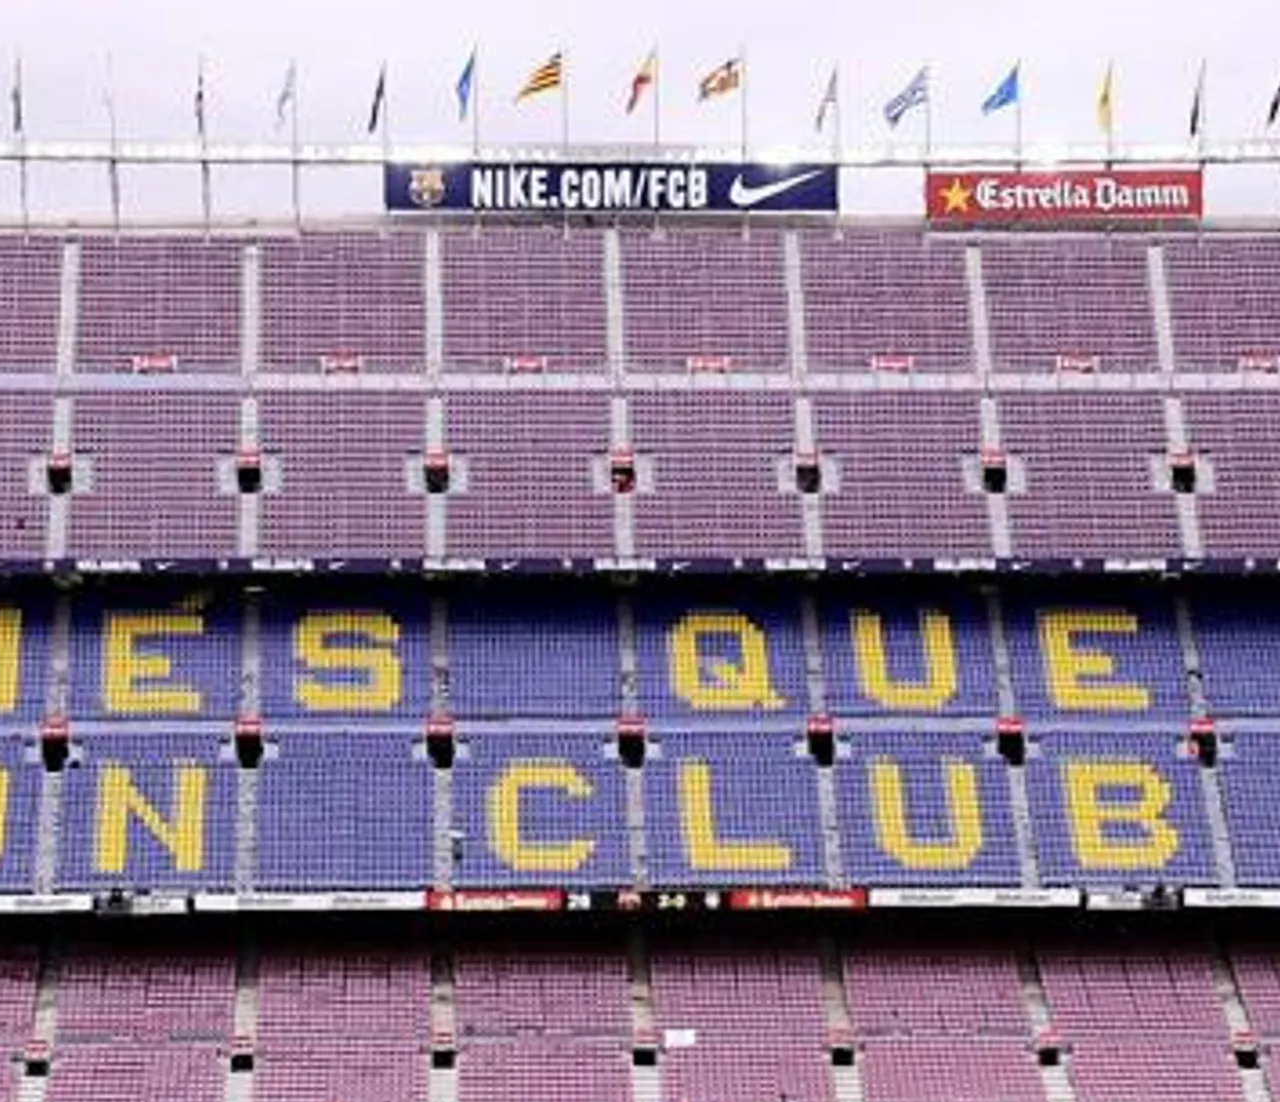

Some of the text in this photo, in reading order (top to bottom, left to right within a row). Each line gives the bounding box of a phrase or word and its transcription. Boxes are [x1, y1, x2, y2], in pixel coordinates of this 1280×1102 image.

[471, 165, 708, 210] NIKE.COM/FCB
[975, 175, 1190, 210] Estrella Damm
[666, 607, 1152, 714] QUE
[486, 757, 1182, 873] CLUB
